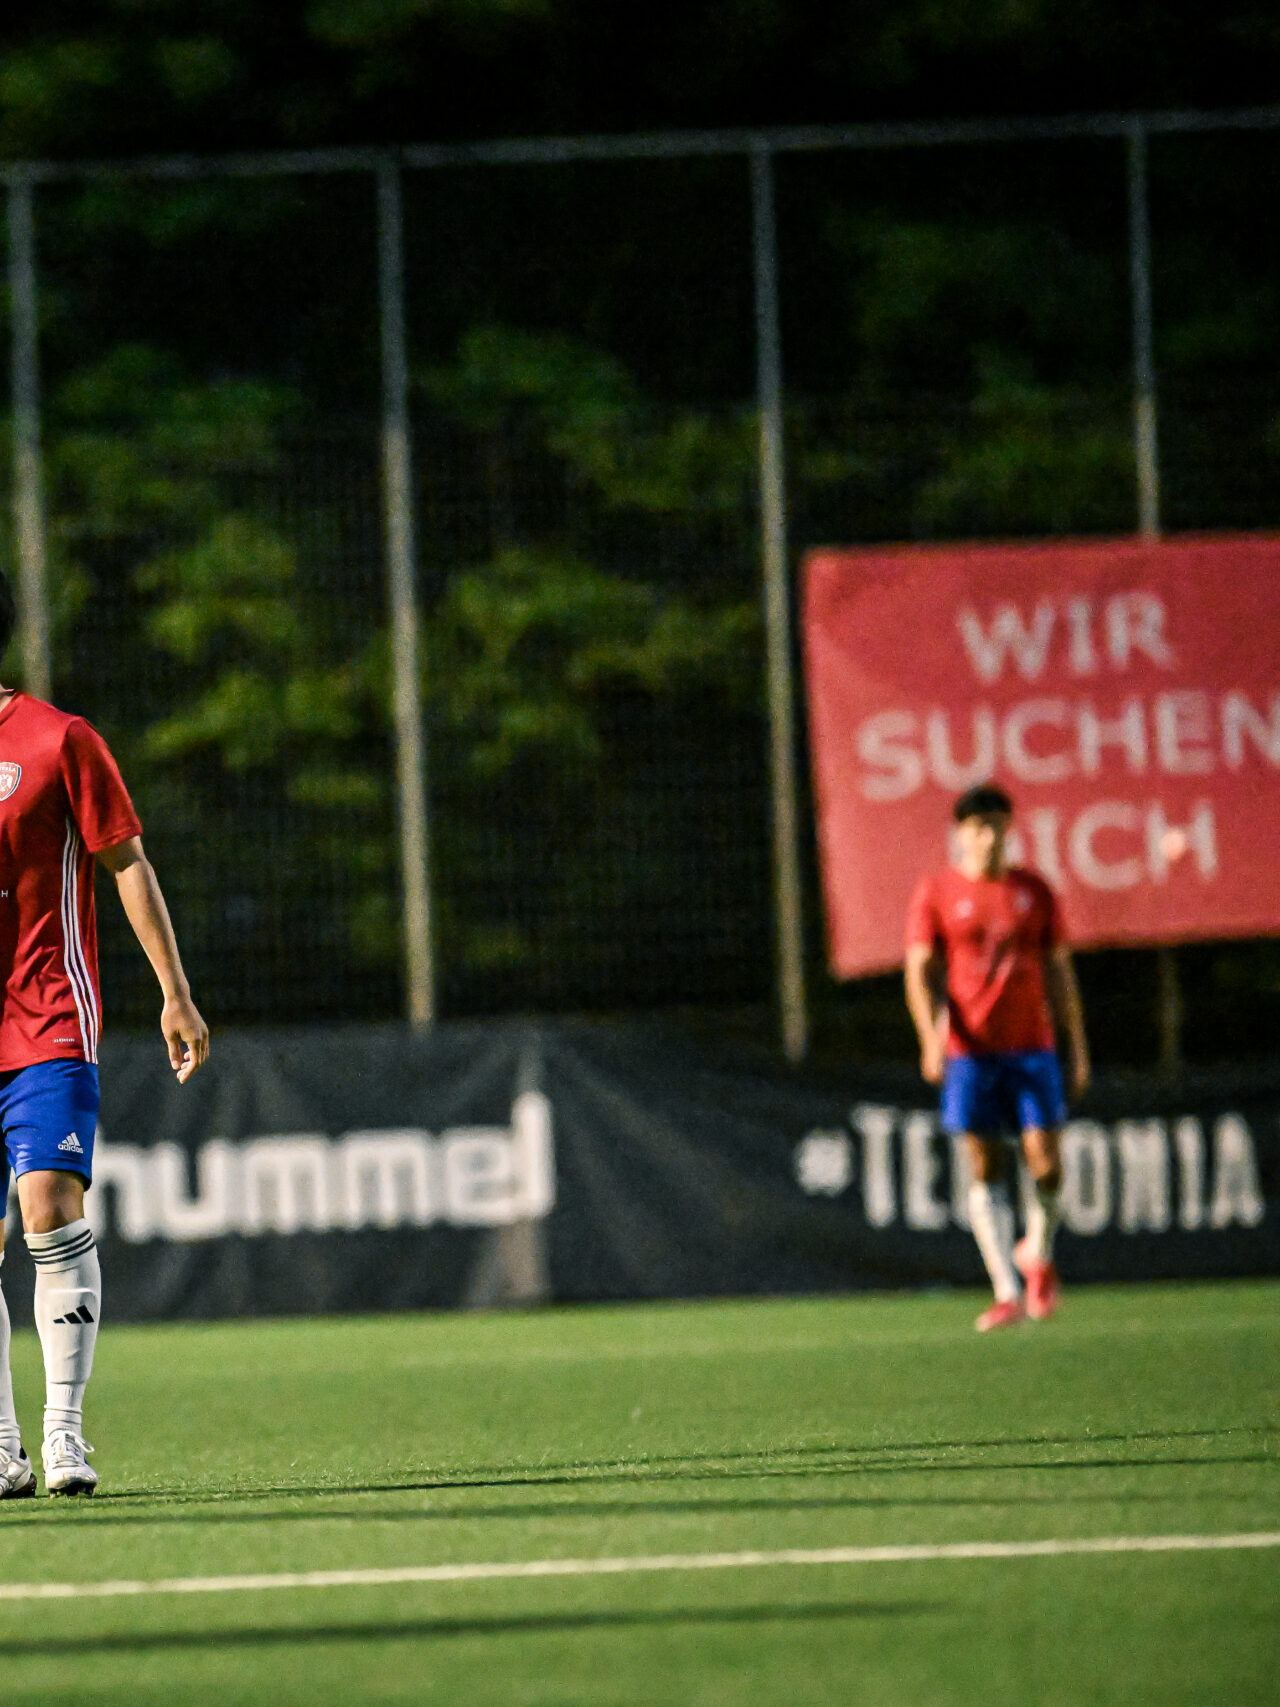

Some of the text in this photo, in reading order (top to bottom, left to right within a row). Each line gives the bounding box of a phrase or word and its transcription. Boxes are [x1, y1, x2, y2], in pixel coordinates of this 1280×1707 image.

[957, 591, 1176, 683] WIR
[855, 689, 1280, 803] SUCHEN
[57, 1143, 84, 1154] adidas
[82, 1092, 556, 1242] hummel
